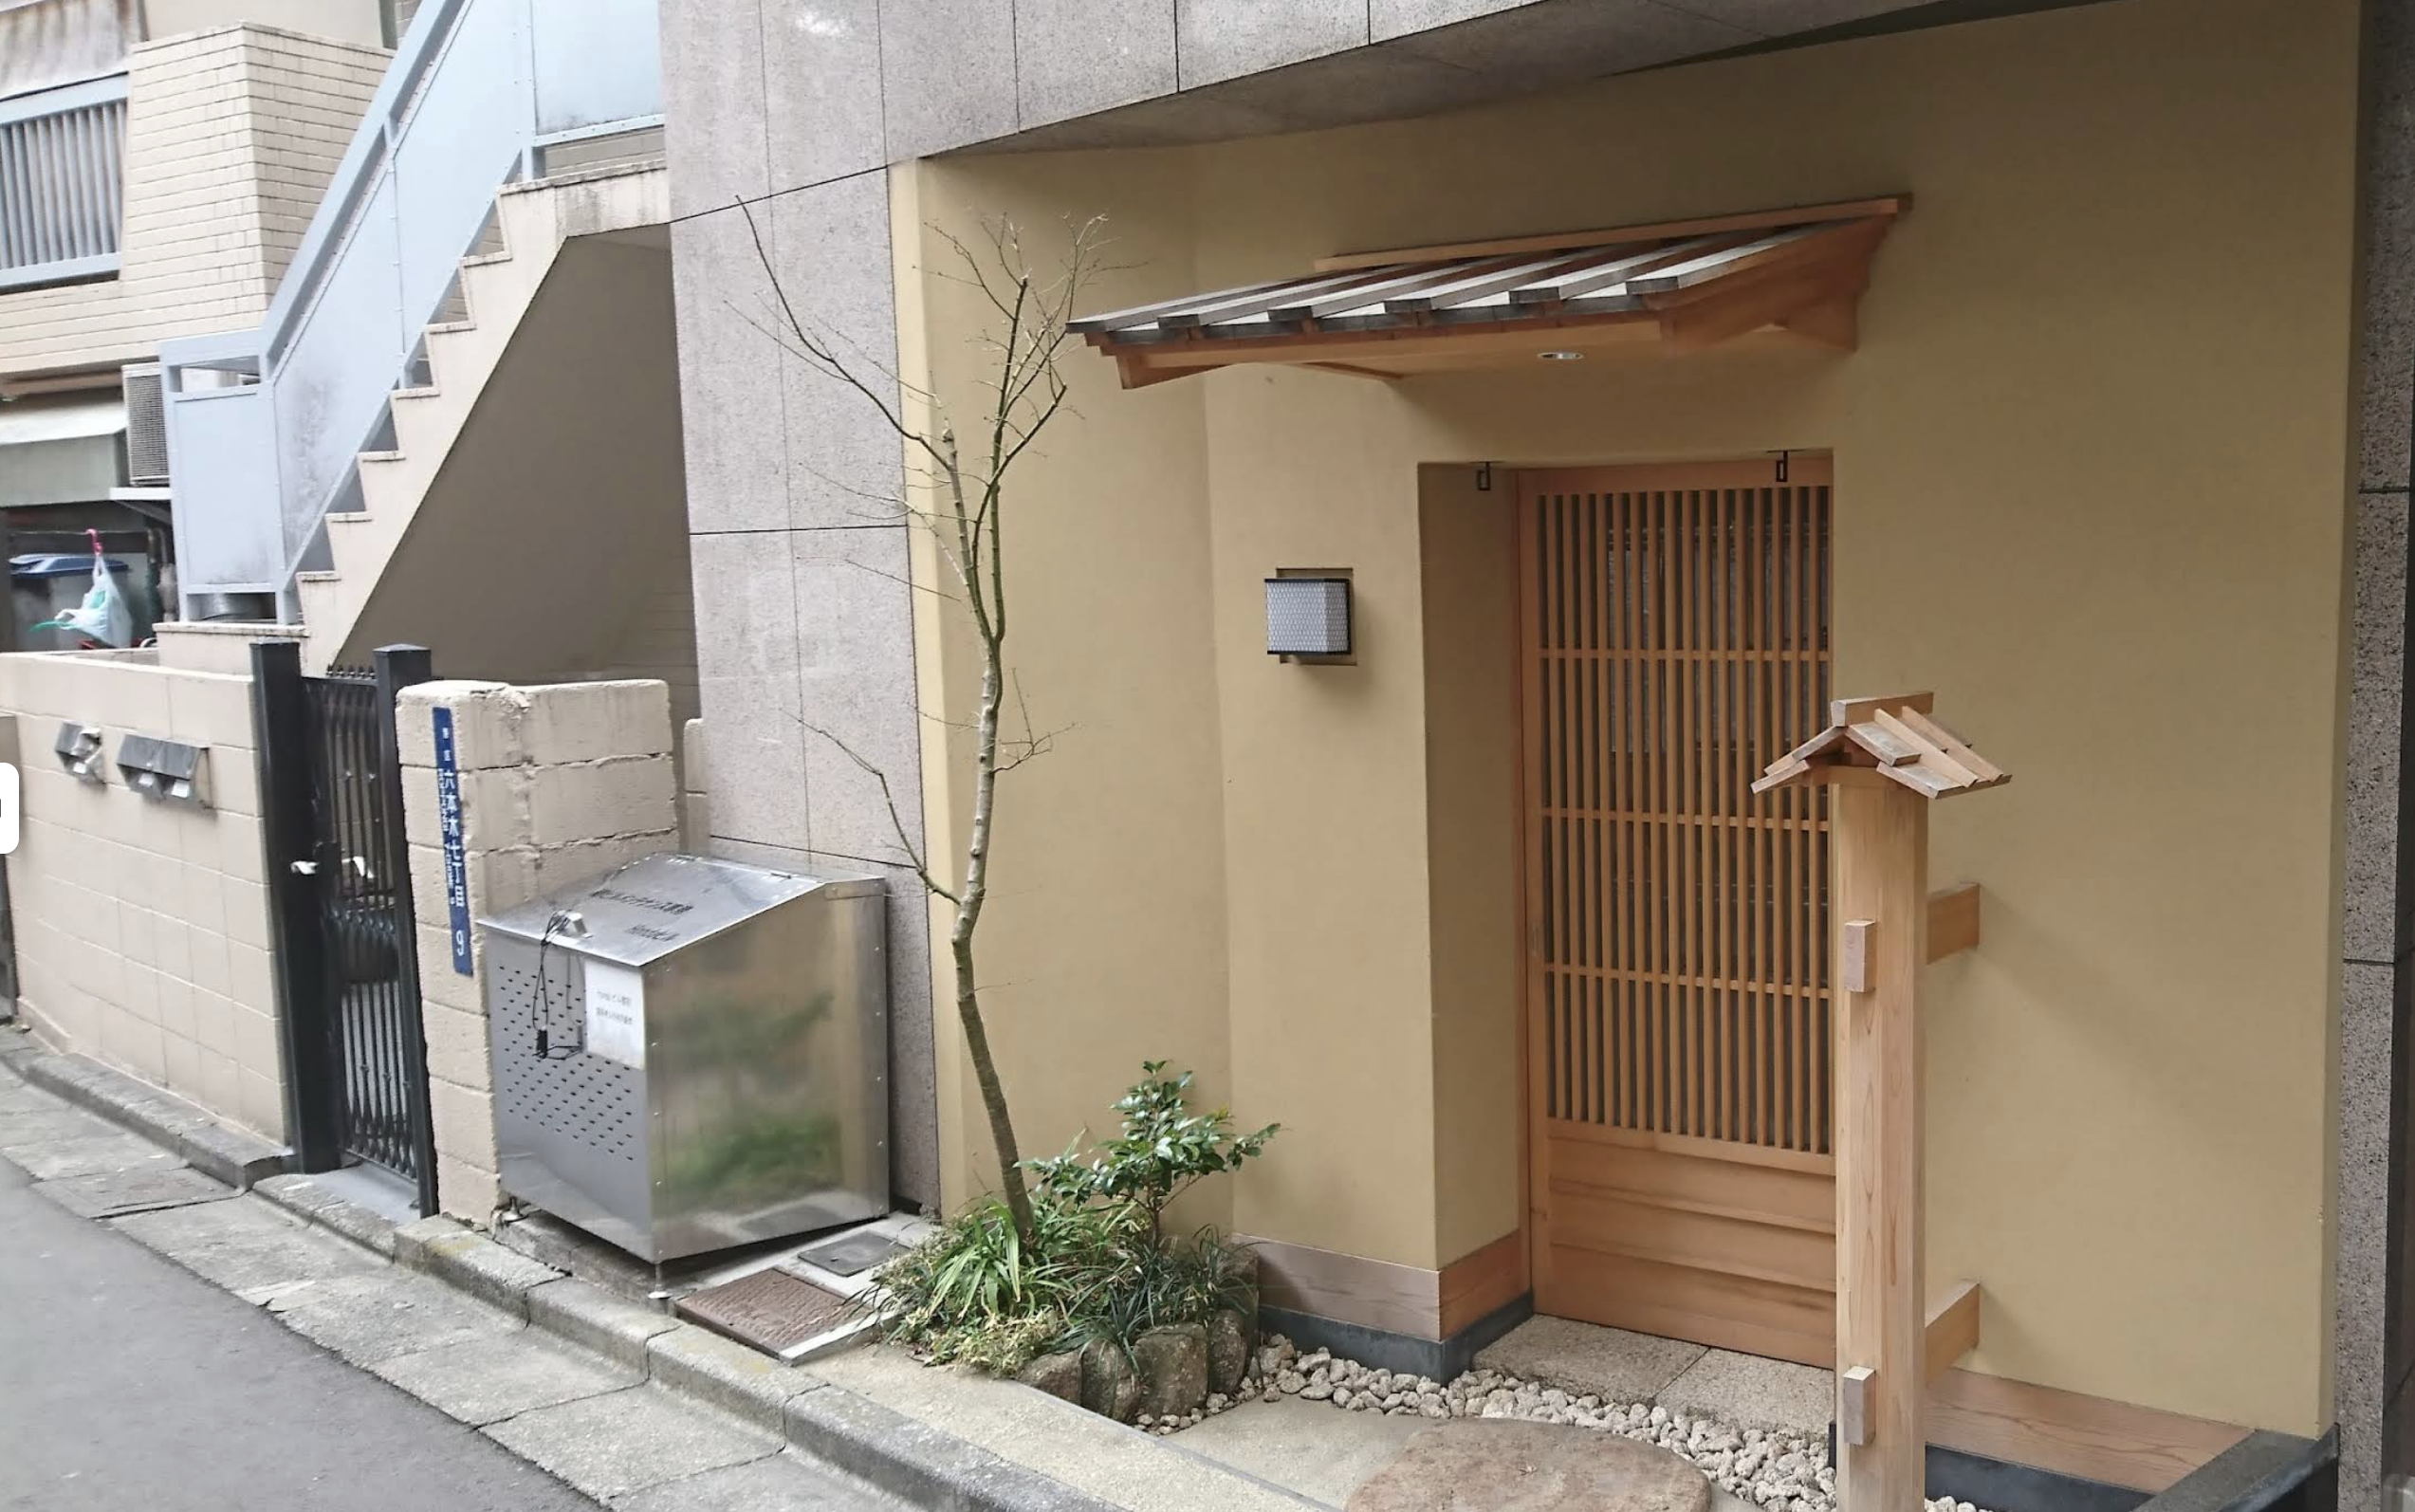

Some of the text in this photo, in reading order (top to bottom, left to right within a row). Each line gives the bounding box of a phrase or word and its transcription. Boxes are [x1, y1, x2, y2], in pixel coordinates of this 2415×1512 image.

[443, 768, 465, 907] 六本木七丁目
[455, 930, 465, 956] 9
